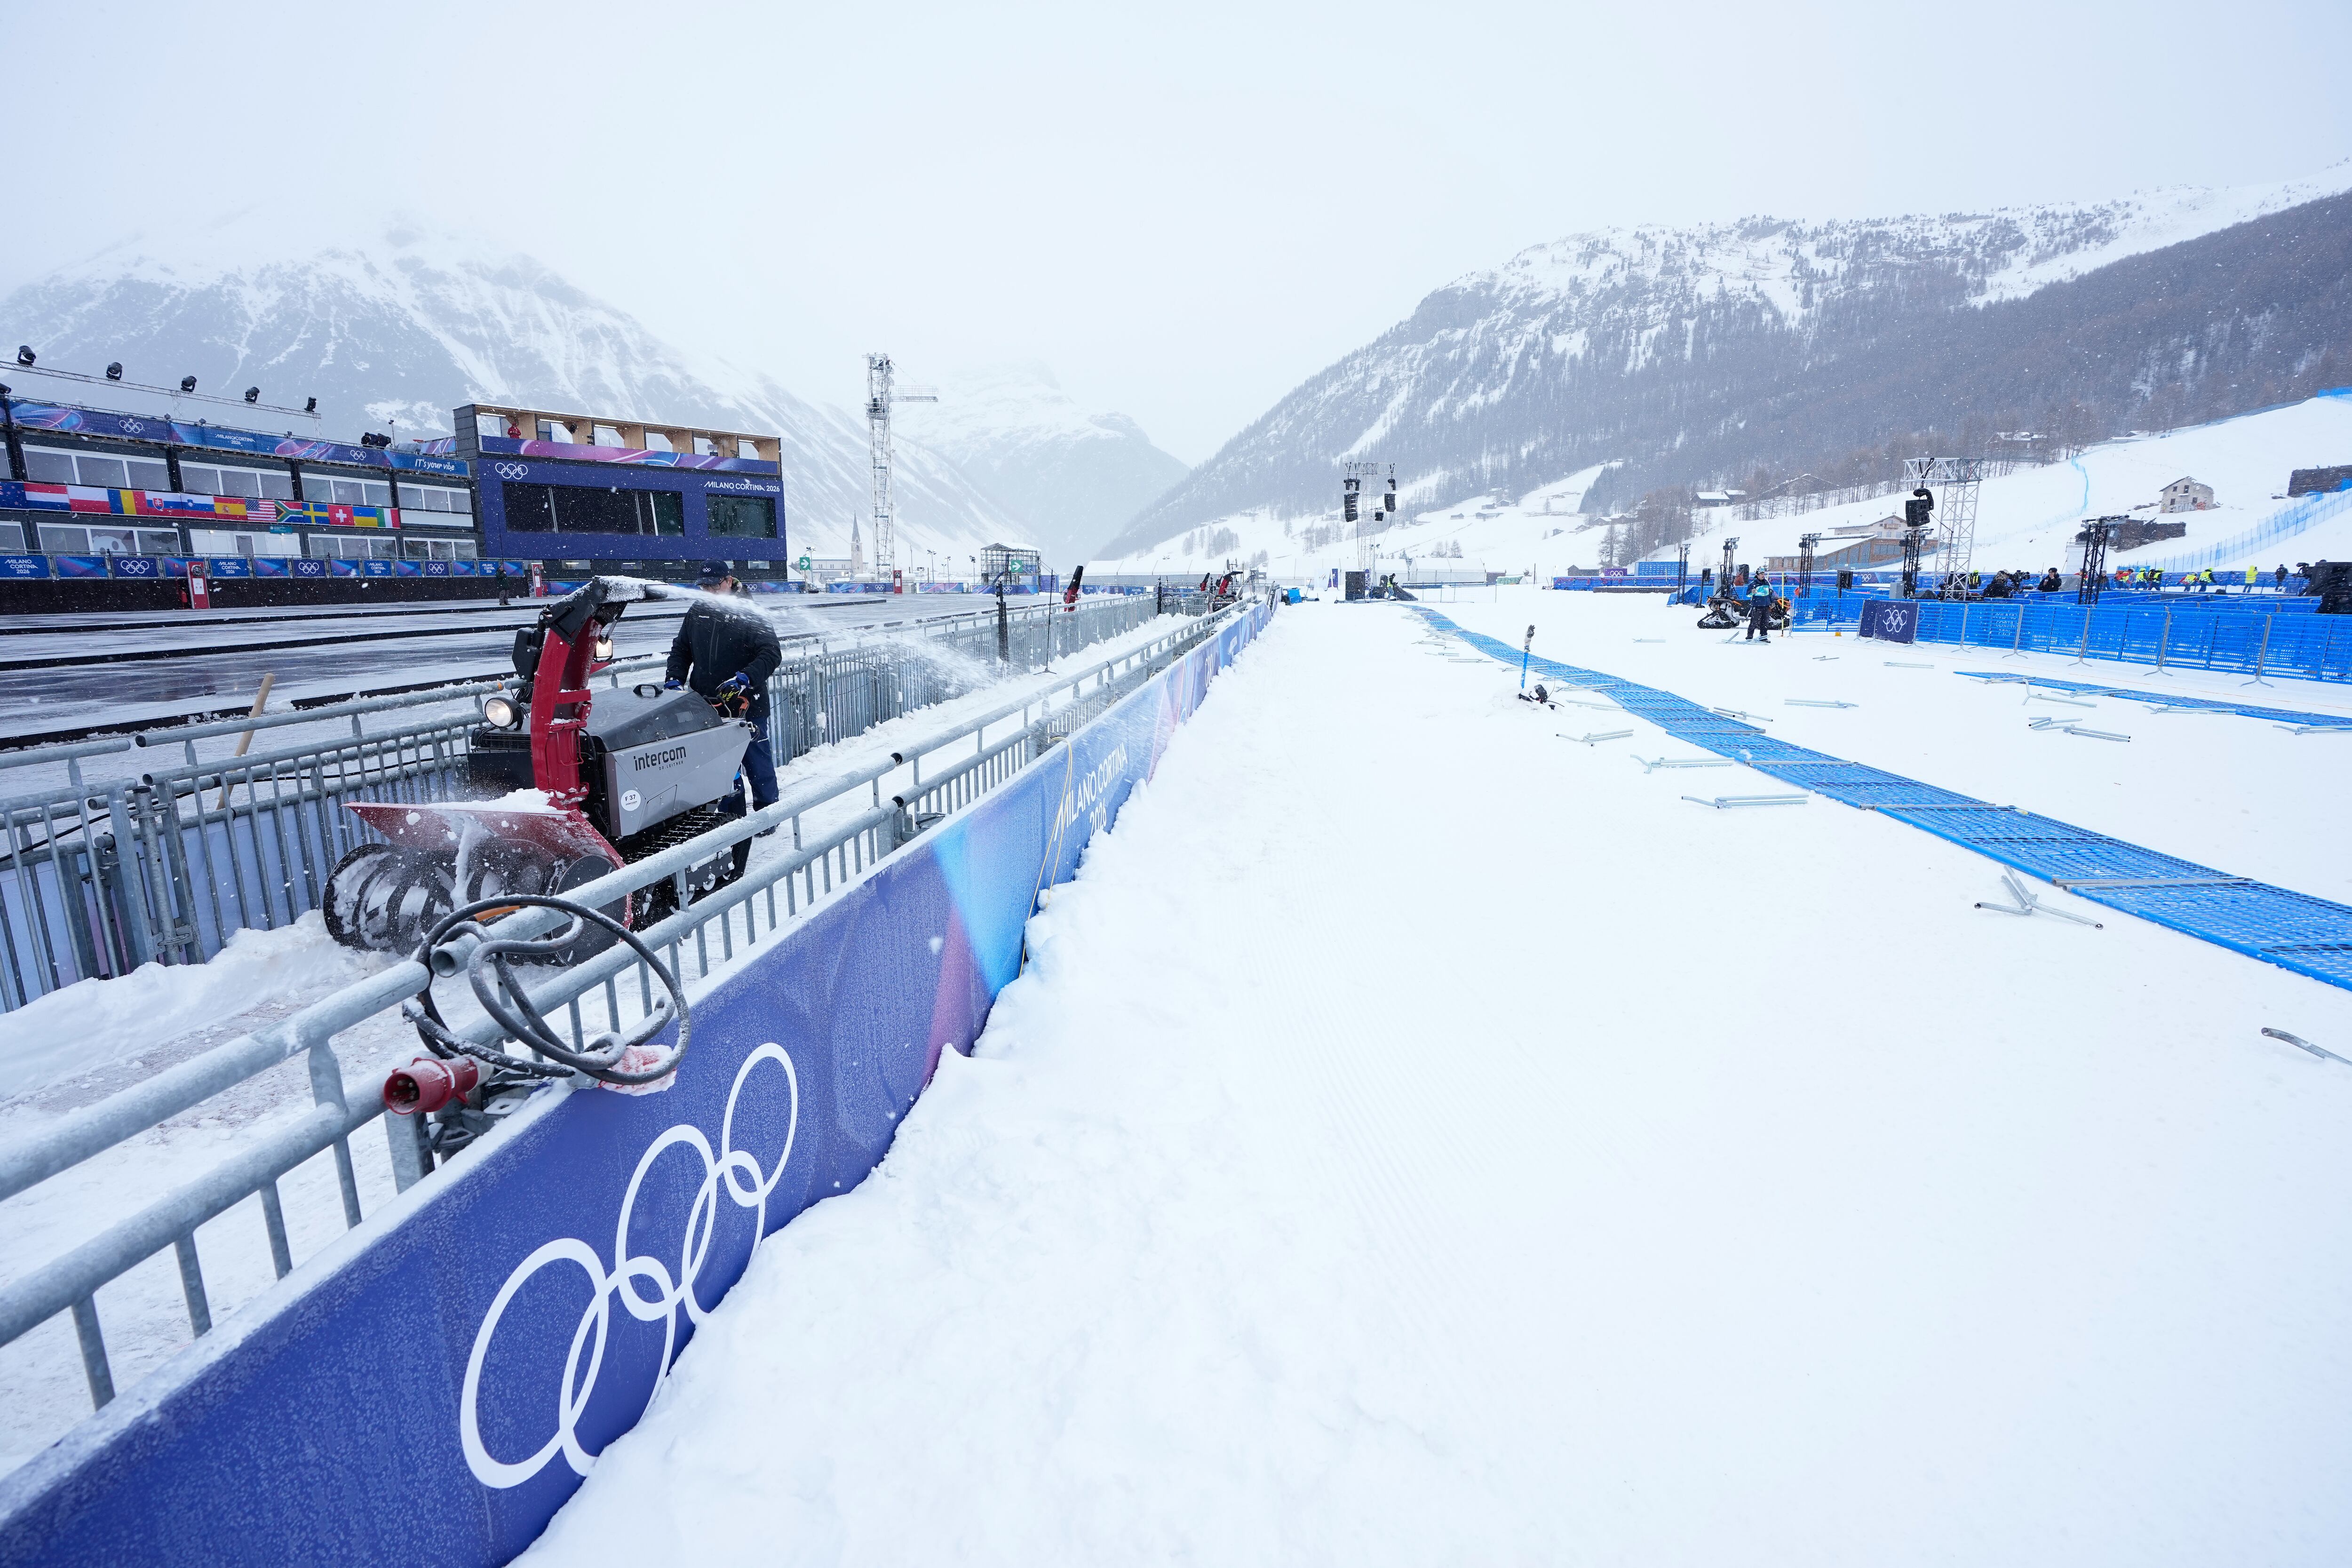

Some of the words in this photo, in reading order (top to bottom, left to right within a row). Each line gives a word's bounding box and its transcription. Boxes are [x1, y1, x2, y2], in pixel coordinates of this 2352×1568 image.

[426, 461, 442, 470] your
[443, 462, 455, 470] vibe
[704, 481, 734, 489] MILANO
[633, 746, 686, 771] intercom
[1054, 771, 1097, 842] MILANO
[1098, 742, 1128, 794] CORTINA
[1089, 797, 1106, 837] 2026
